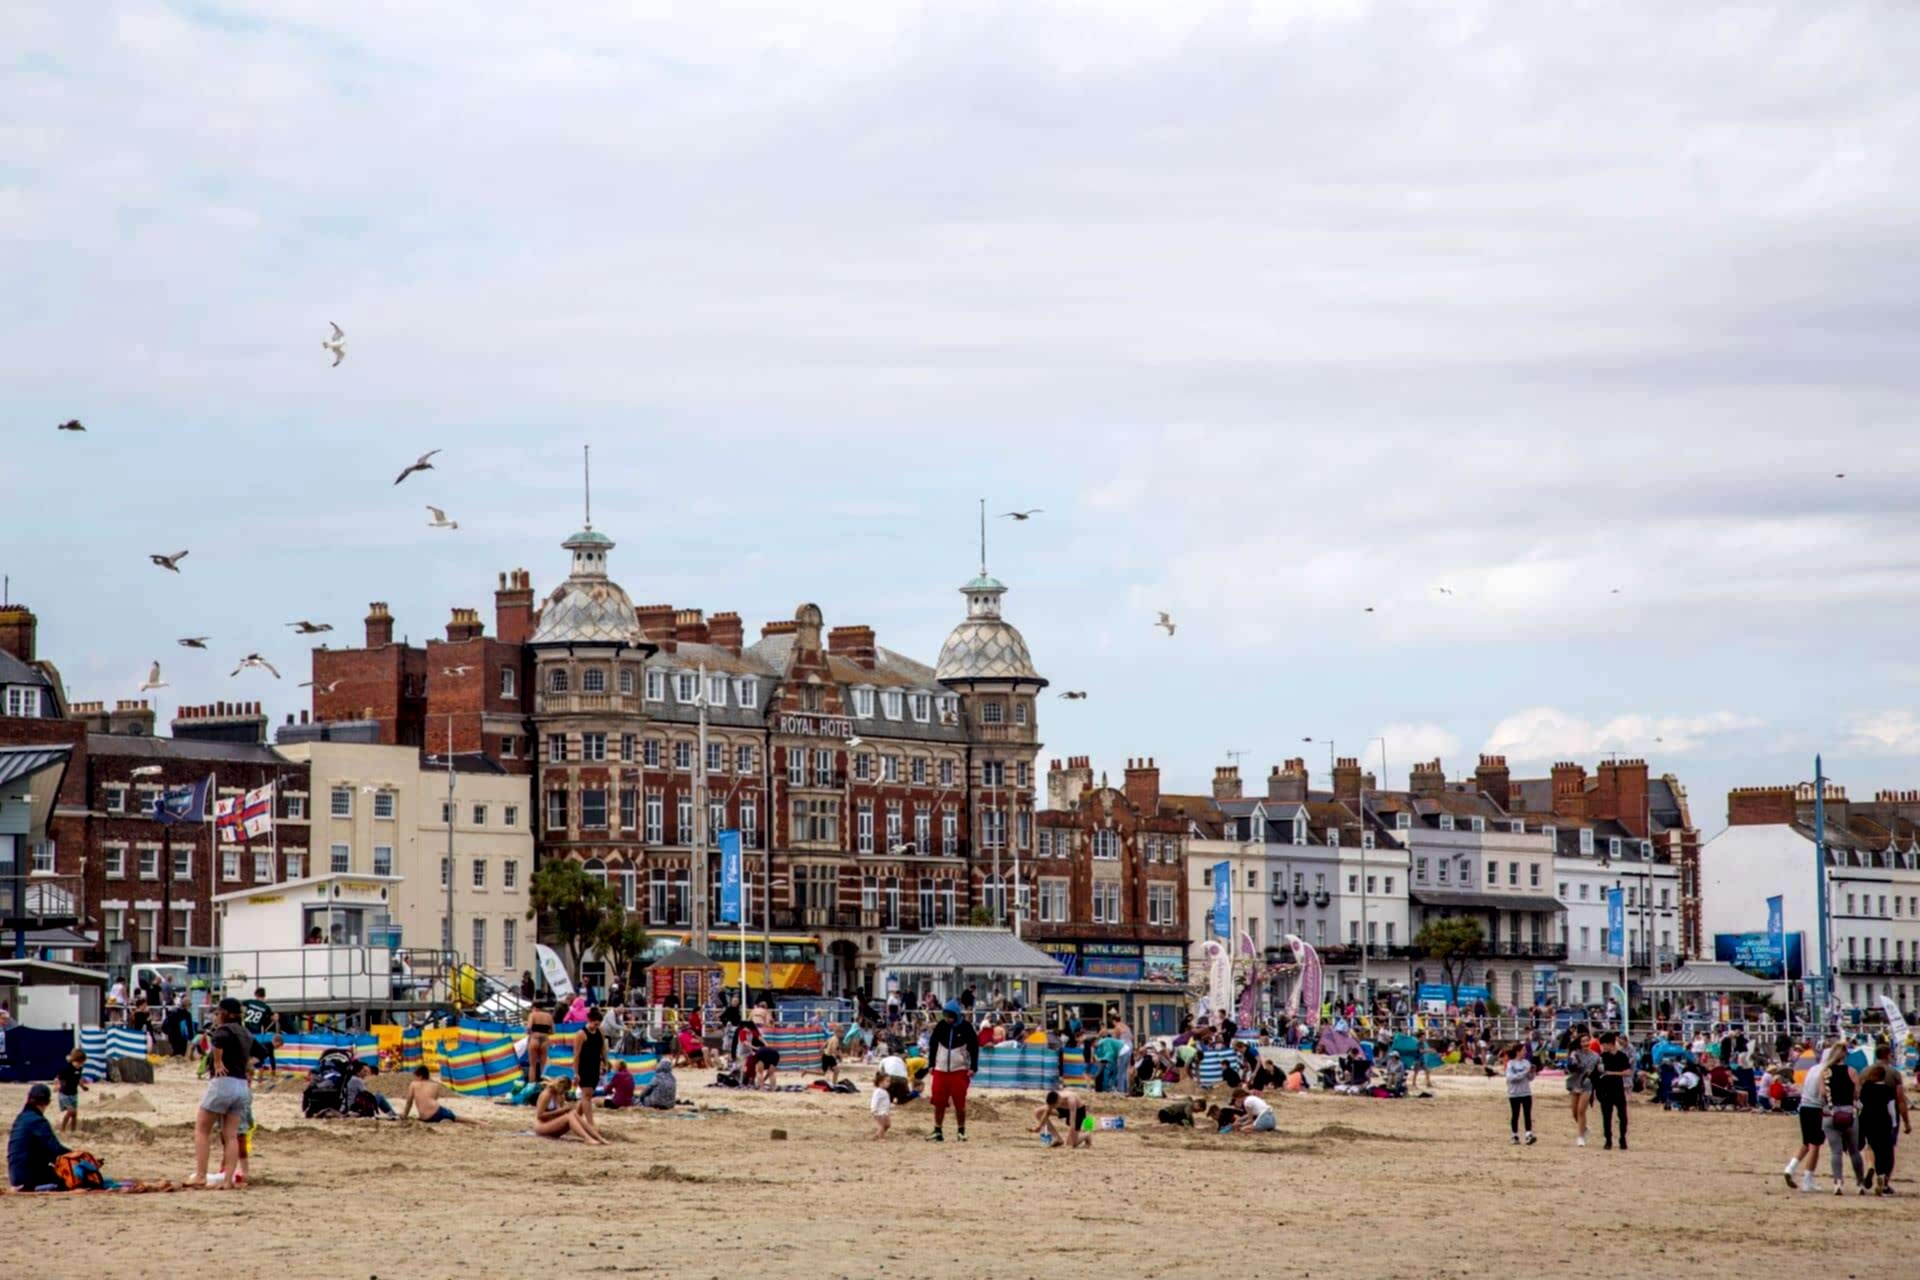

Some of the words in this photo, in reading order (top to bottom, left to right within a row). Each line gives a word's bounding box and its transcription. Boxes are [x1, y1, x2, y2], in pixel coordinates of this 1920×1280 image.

[780, 716, 816, 735] ROYAL
[820, 719, 856, 738] HOTEL
[244, 1009, 263, 1024] 28
